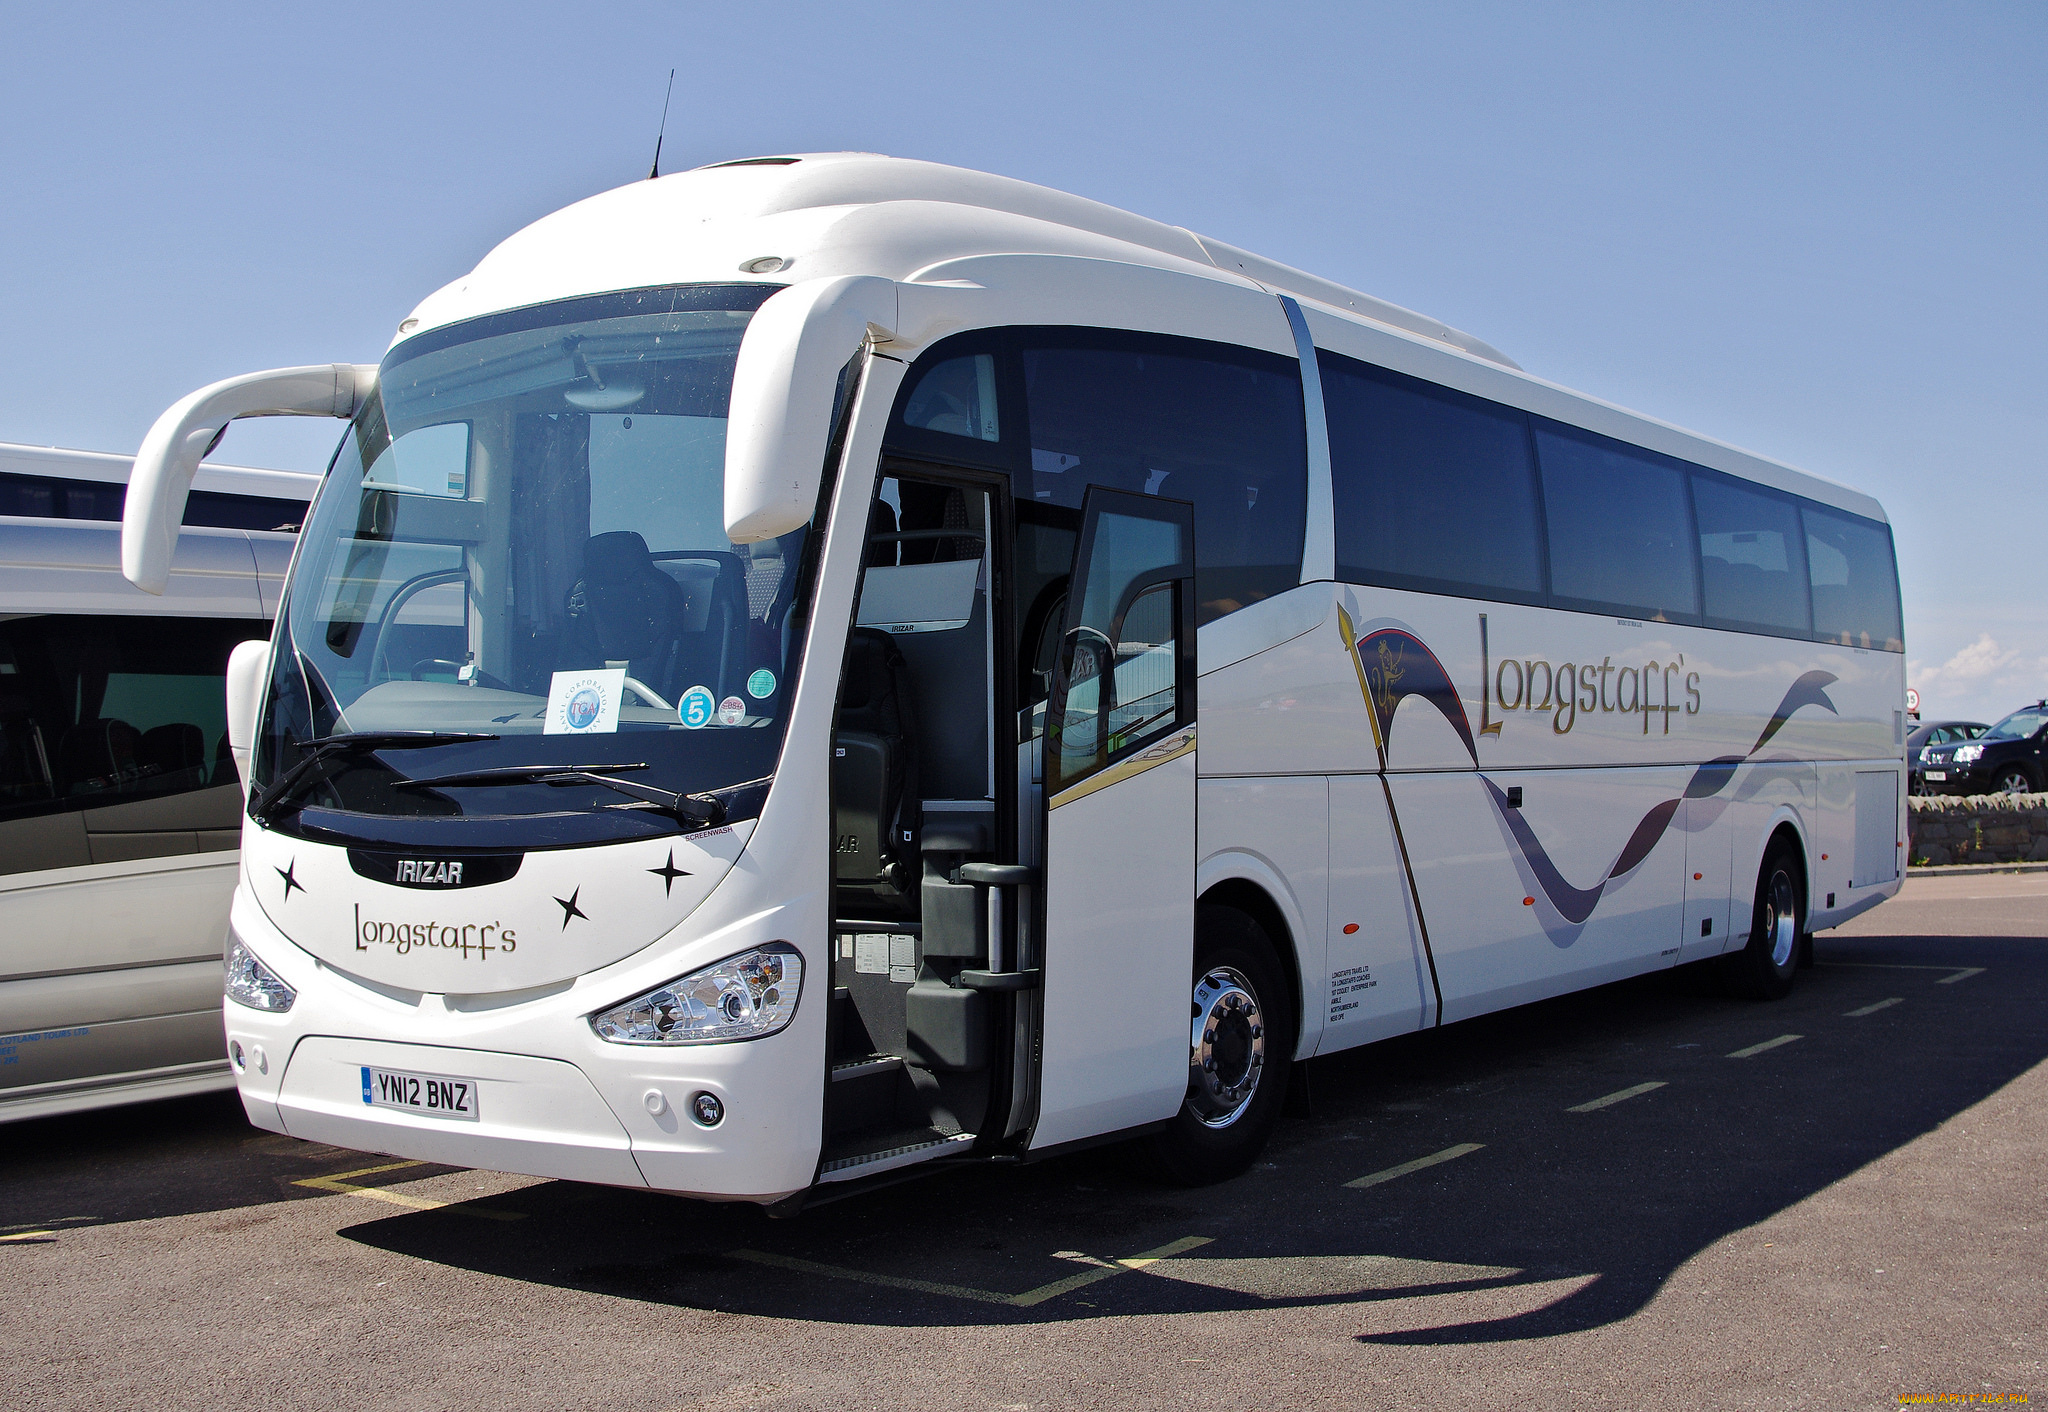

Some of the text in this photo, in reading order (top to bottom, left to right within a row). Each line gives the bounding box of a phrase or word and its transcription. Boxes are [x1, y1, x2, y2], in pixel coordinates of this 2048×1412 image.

[1478, 613, 1701, 739] Longstaff's
[571, 702, 595, 715] TCA
[687, 700, 704, 724] 5
[685, 826, 733, 842] SCREENWASH
[396, 860, 463, 884] IRIZAR
[354, 903, 517, 961] Longstaff's
[1350, 982, 1369, 992] ENTERPRISE
[1330, 1001, 1359, 1013] NORTHUMBERLAND
[43, 1029, 72, 1040] TOURS
[378, 1073, 468, 1112] YN12 BNZ
